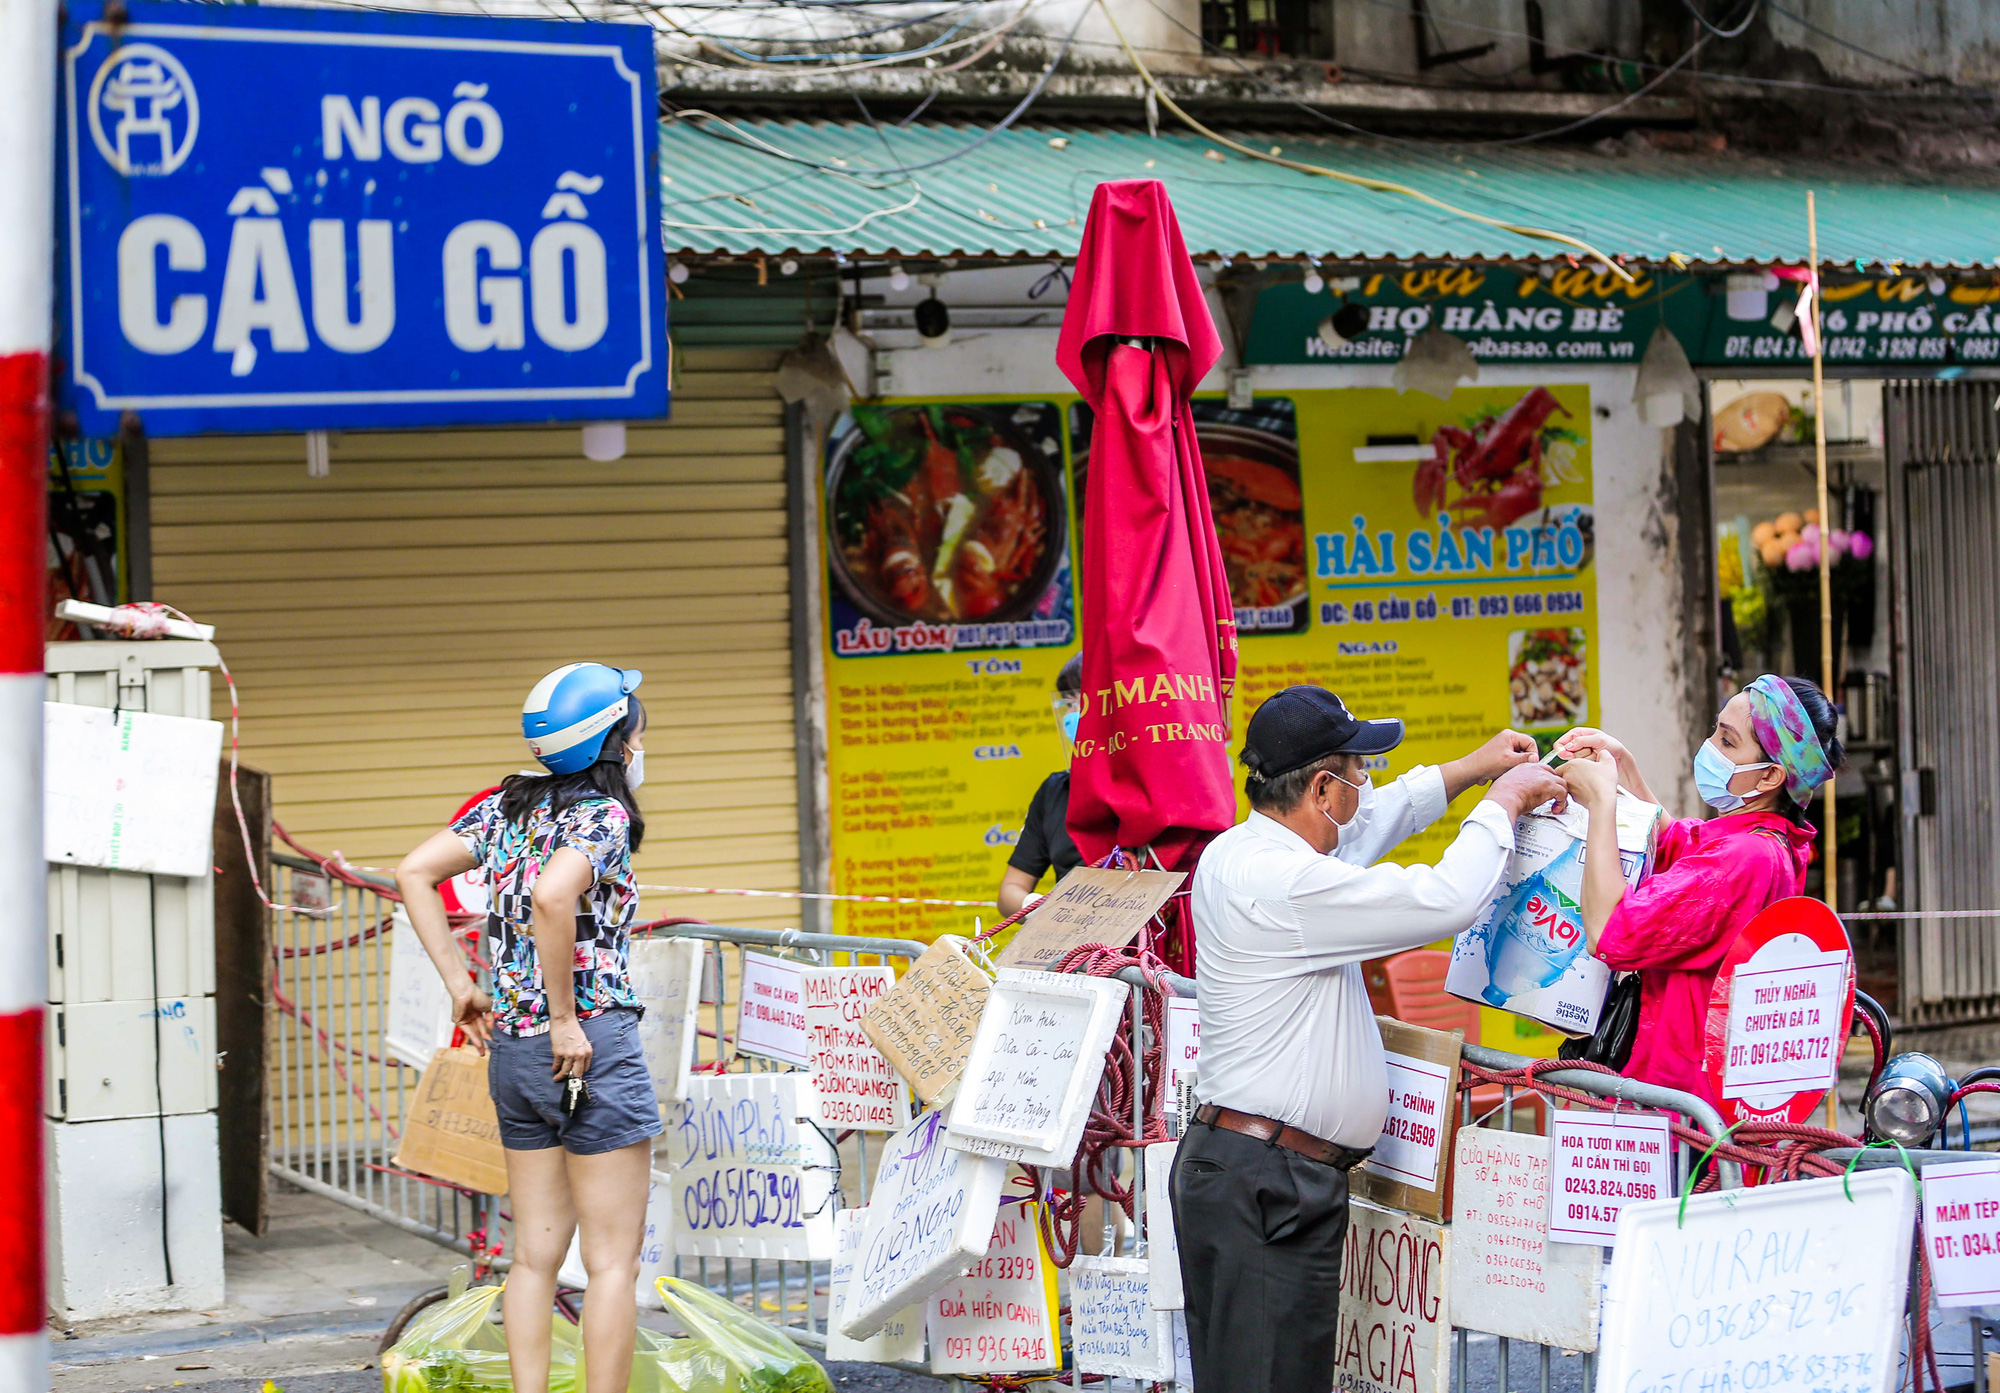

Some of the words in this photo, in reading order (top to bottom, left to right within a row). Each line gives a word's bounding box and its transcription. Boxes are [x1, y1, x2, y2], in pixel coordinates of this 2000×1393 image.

[321, 82, 502, 165] NGÕ
[117, 168, 396, 376] CẦU
[442, 171, 609, 353] GỖ
[1367, 303, 1431, 334] HỢ
[1442, 301, 1562, 331] HÀNG
[1571, 302, 1624, 332] BÈ
[1314, 515, 1397, 576] HẢI
[1407, 512, 1495, 573] SẢN
[1504, 507, 1585, 569] PHỐ
[1352, 600, 1374, 621] 46
[1478, 595, 1509, 618] 093
[1546, 591, 1584, 613] 0934
[1338, 640, 1398, 656] NGAO
[967, 657, 1021, 675] TÔM
[1113, 673, 1216, 709] MẠNH
[1145, 722, 1223, 744] TRANG
[973, 743, 1022, 761] CUA
[1754, 980, 1781, 1005] THỦY
[1783, 980, 1816, 1002] NGHĨA
[1745, 1011, 1787, 1033] CHUYÊN
[1789, 1009, 1804, 1028] GÀ
[1807, 1009, 1820, 1026] TA
[1730, 1045, 1748, 1067] ĐT:
[1750, 1036, 1830, 1066] 0912.643.712
[1403, 1091, 1435, 1116] CHỈNH
[1561, 1135, 1584, 1149] HOA
[1587, 1136, 1612, 1151] TƯƠI
[1615, 1139, 1636, 1152] KIM
[1639, 1141, 1660, 1155] ANH
[1487, 1144, 1521, 1169] HÀNG
[1527, 1155, 1548, 1175] TẠP
[1571, 1155, 1583, 1168] AI
[1586, 1153, 1610, 1170] CẦN
[1613, 1156, 1630, 1172] THÌ
[1633, 1160, 1651, 1176] GỌI
[1565, 1177, 1657, 1200] 0243.824.0596
[1568, 1203, 1623, 1223] 0914.57
[1936, 1199, 1970, 1223] MẮM
[1974, 1197, 2000, 1219] TÉP
[1934, 1235, 1959, 1259] ĐT:
[940, 1289, 967, 1319] QUẢ
[1006, 1302, 1041, 1327] OANH
[946, 1337, 972, 1359] 097
[977, 1335, 1007, 1363] 936
